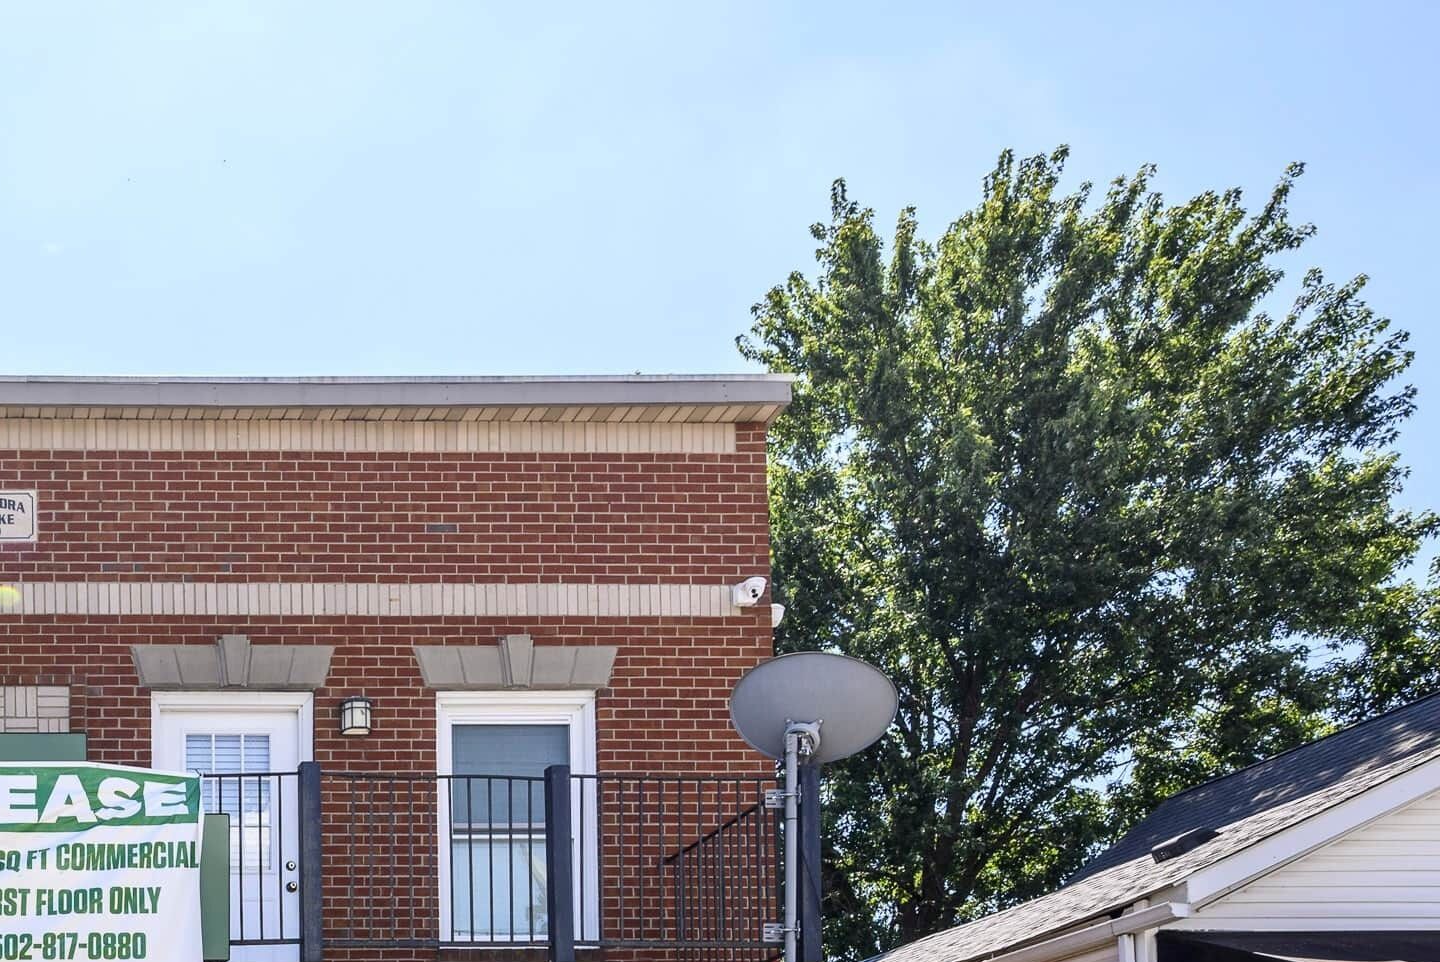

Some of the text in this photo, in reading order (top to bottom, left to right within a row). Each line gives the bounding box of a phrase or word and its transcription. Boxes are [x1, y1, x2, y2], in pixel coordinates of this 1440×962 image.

[26, 847, 51, 870] FT
[56, 840, 199, 871] COMMERCIAL
[35, 888, 103, 916] FLOOR
[109, 886, 162, 914] ONLY
